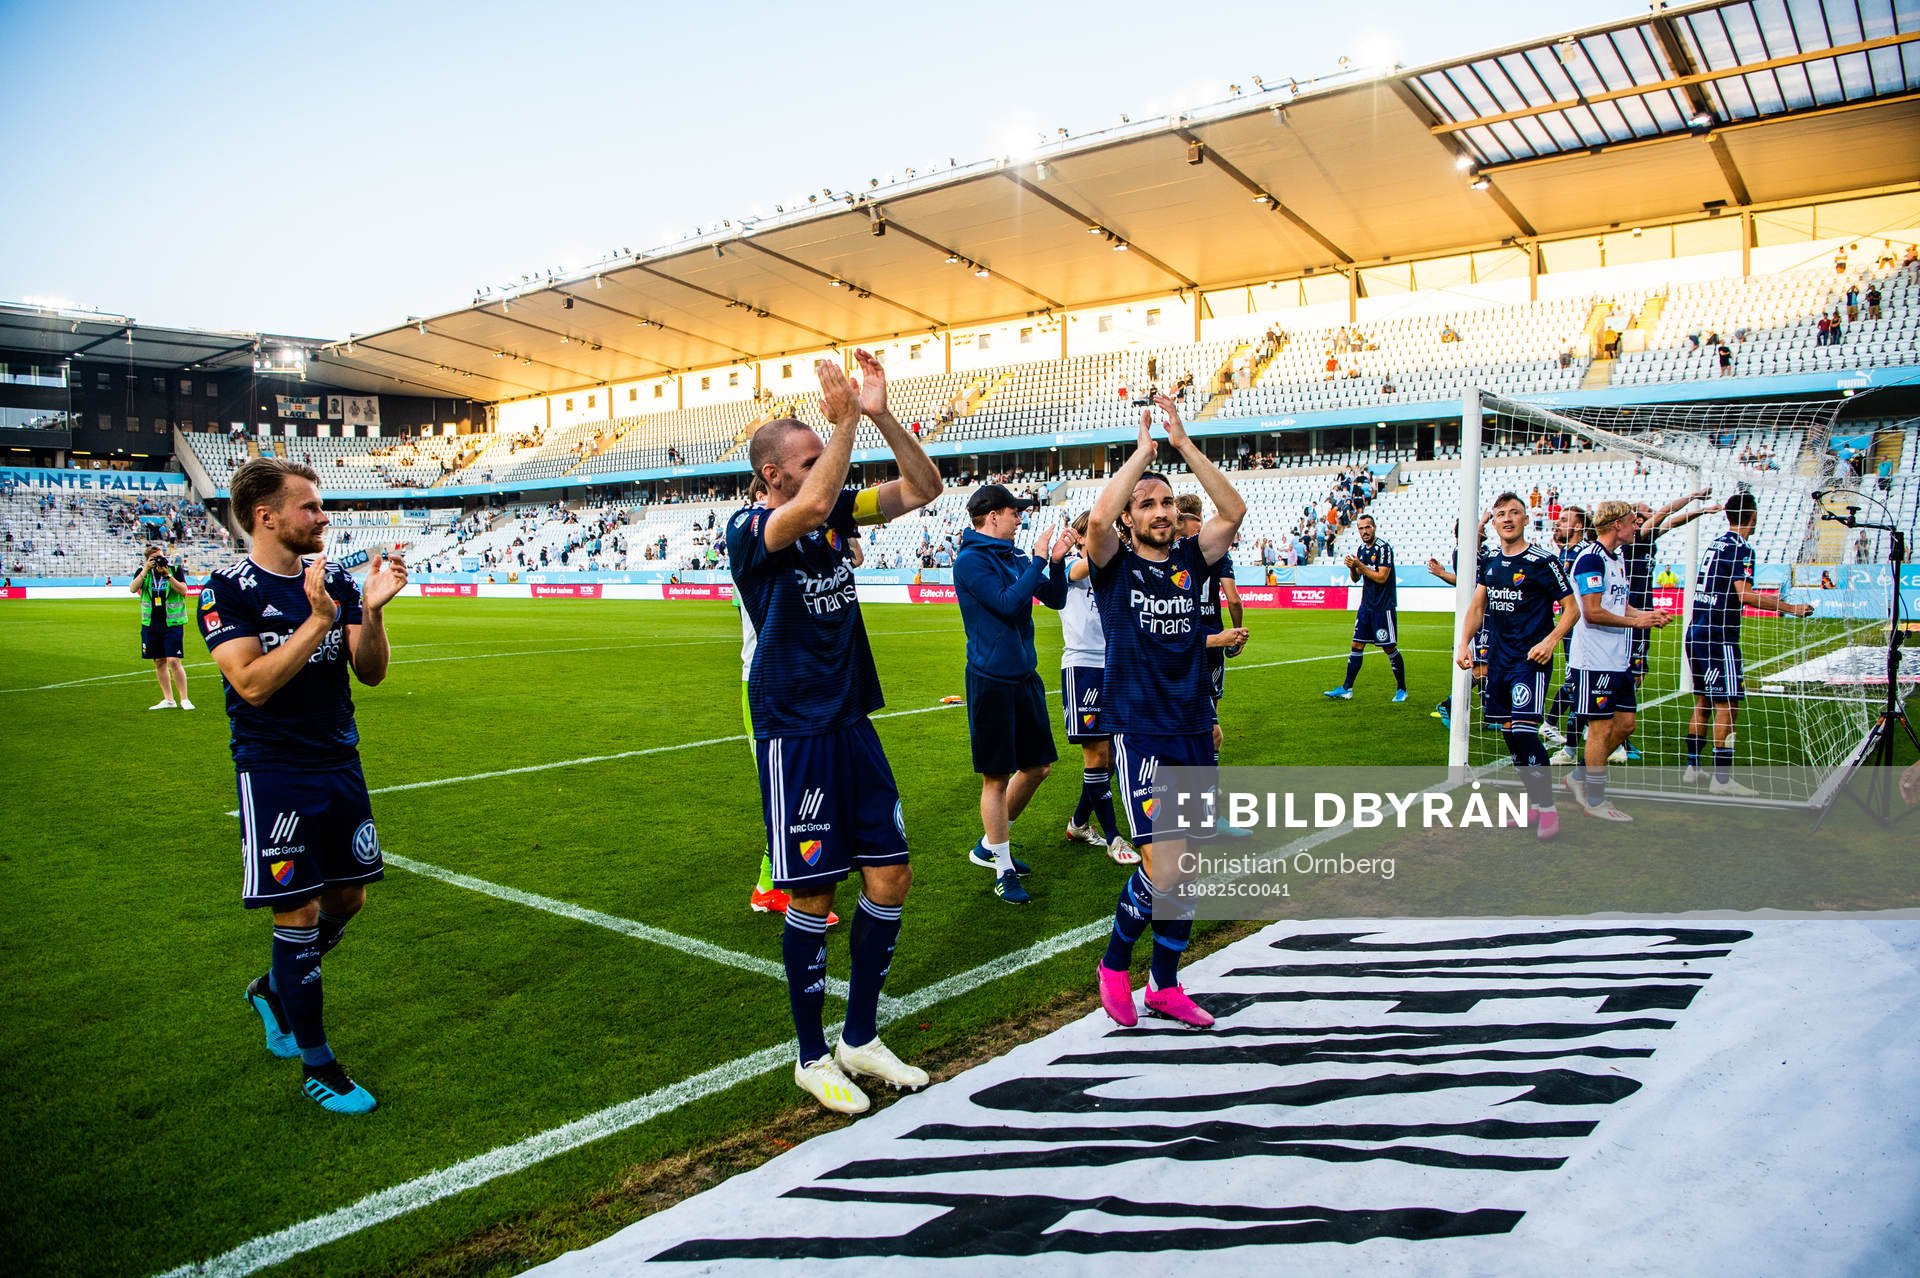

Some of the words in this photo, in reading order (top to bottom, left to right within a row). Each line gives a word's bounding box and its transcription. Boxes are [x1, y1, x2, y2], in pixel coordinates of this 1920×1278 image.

[39, 472, 92, 489] INTE
[100, 474, 168, 492] FALLA
[920, 589, 944, 598] Edtech
[944, 589, 956, 598] for
[1241, 591, 1273, 602] usiness
[1292, 590, 1325, 600] TICTAC
[803, 585, 857, 615] Finans
[1130, 589, 1195, 615] Priorite
[1139, 611, 1192, 635] Finans
[1133, 789, 1148, 798] NRC
[1147, 785, 1168, 794] Group
[790, 824, 807, 834] NRC
[807, 823, 831, 832] Group
[262, 848, 281, 857] NRC
[281, 845, 306, 855] Group
